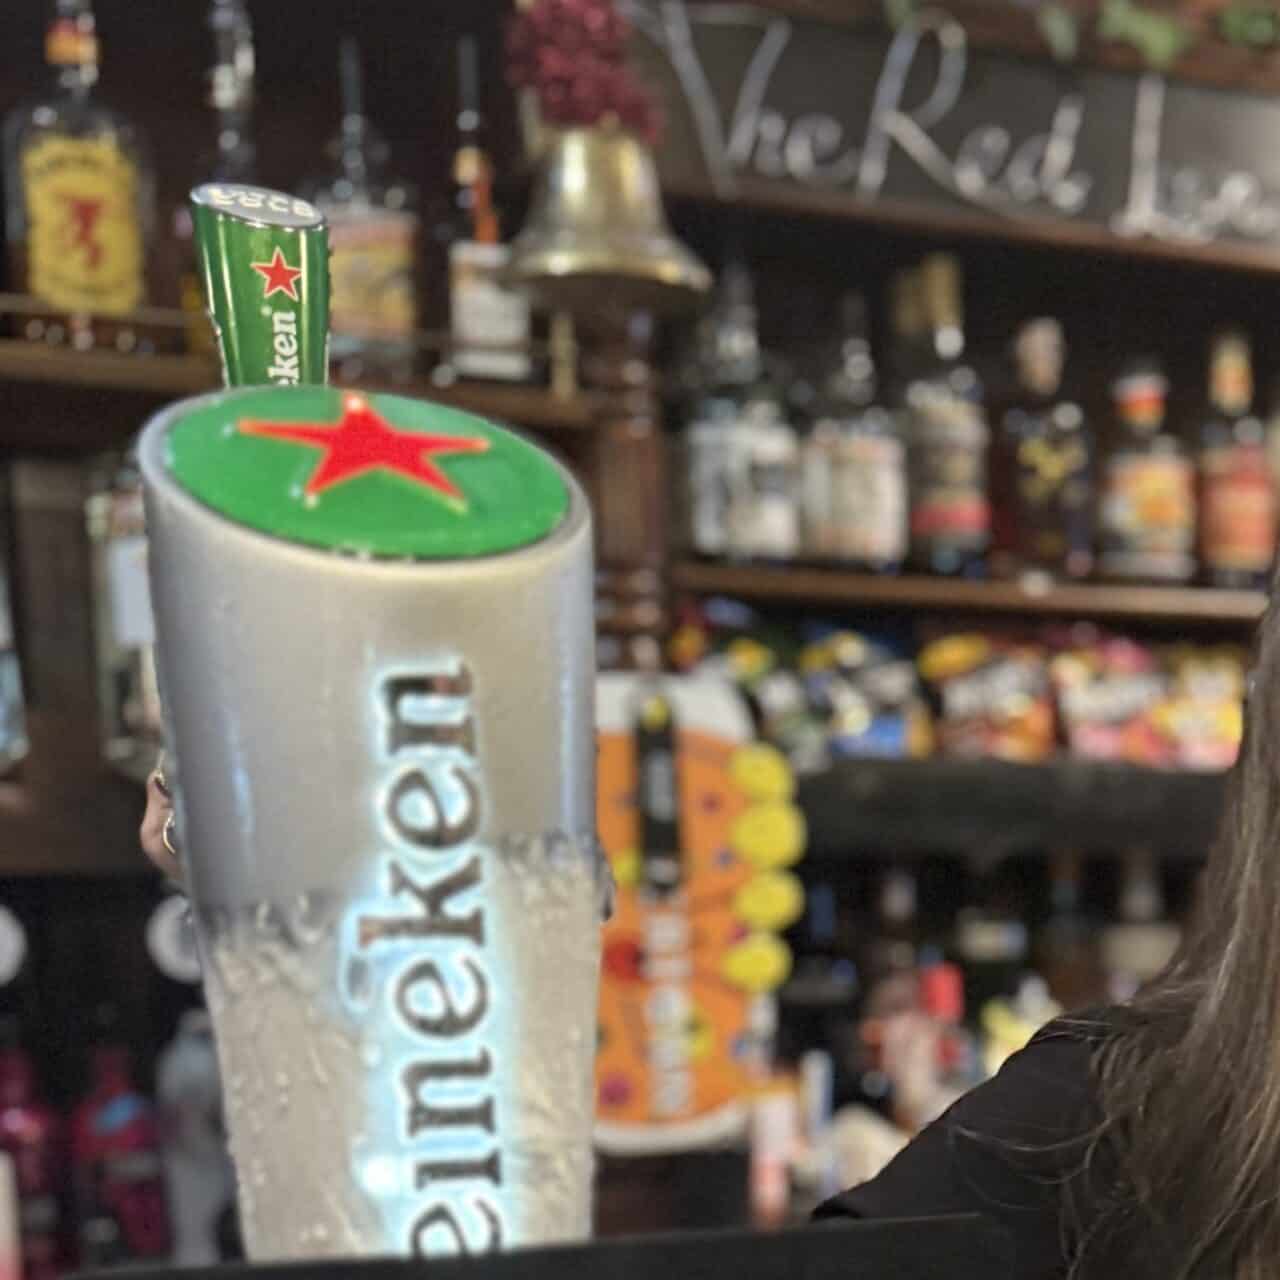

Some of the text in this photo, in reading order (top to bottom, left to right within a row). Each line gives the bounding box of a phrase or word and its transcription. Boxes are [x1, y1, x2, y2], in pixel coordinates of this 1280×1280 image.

[855, 12, 1092, 213] Red
[268, 311, 300, 386] ken
[356, 655, 503, 1258] eineken
